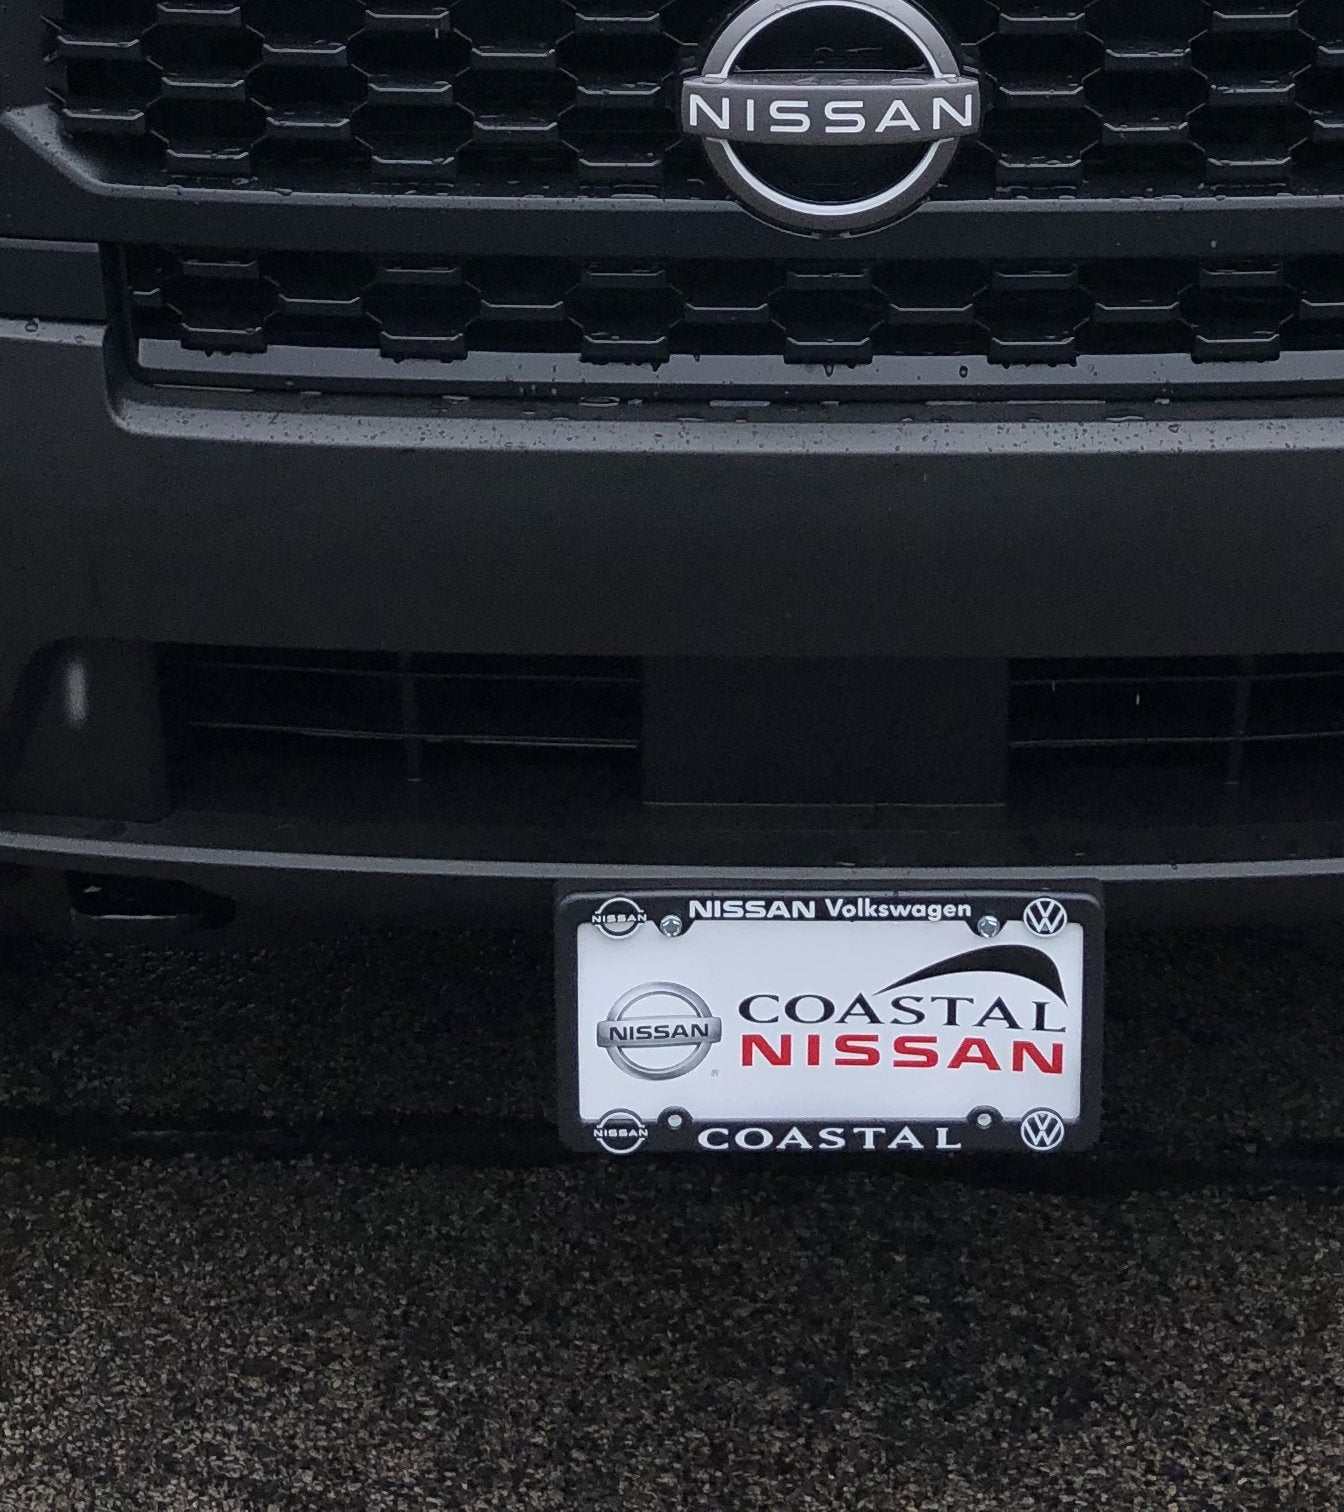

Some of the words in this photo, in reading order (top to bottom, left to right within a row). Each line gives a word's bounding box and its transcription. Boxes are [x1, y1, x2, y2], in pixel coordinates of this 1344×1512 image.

[689, 93, 973, 133] NISSAN
[591, 913, 647, 924] NISSAN
[688, 900, 816, 919] NISSAN
[824, 897, 972, 922] Volkswagen
[738, 991, 1067, 1033] COASTAL
[608, 1023, 710, 1042] NISSAN
[741, 1034, 1064, 1075] NISSAN
[593, 1128, 649, 1138] NISSAN
[697, 1125, 962, 1151] COASTAL
